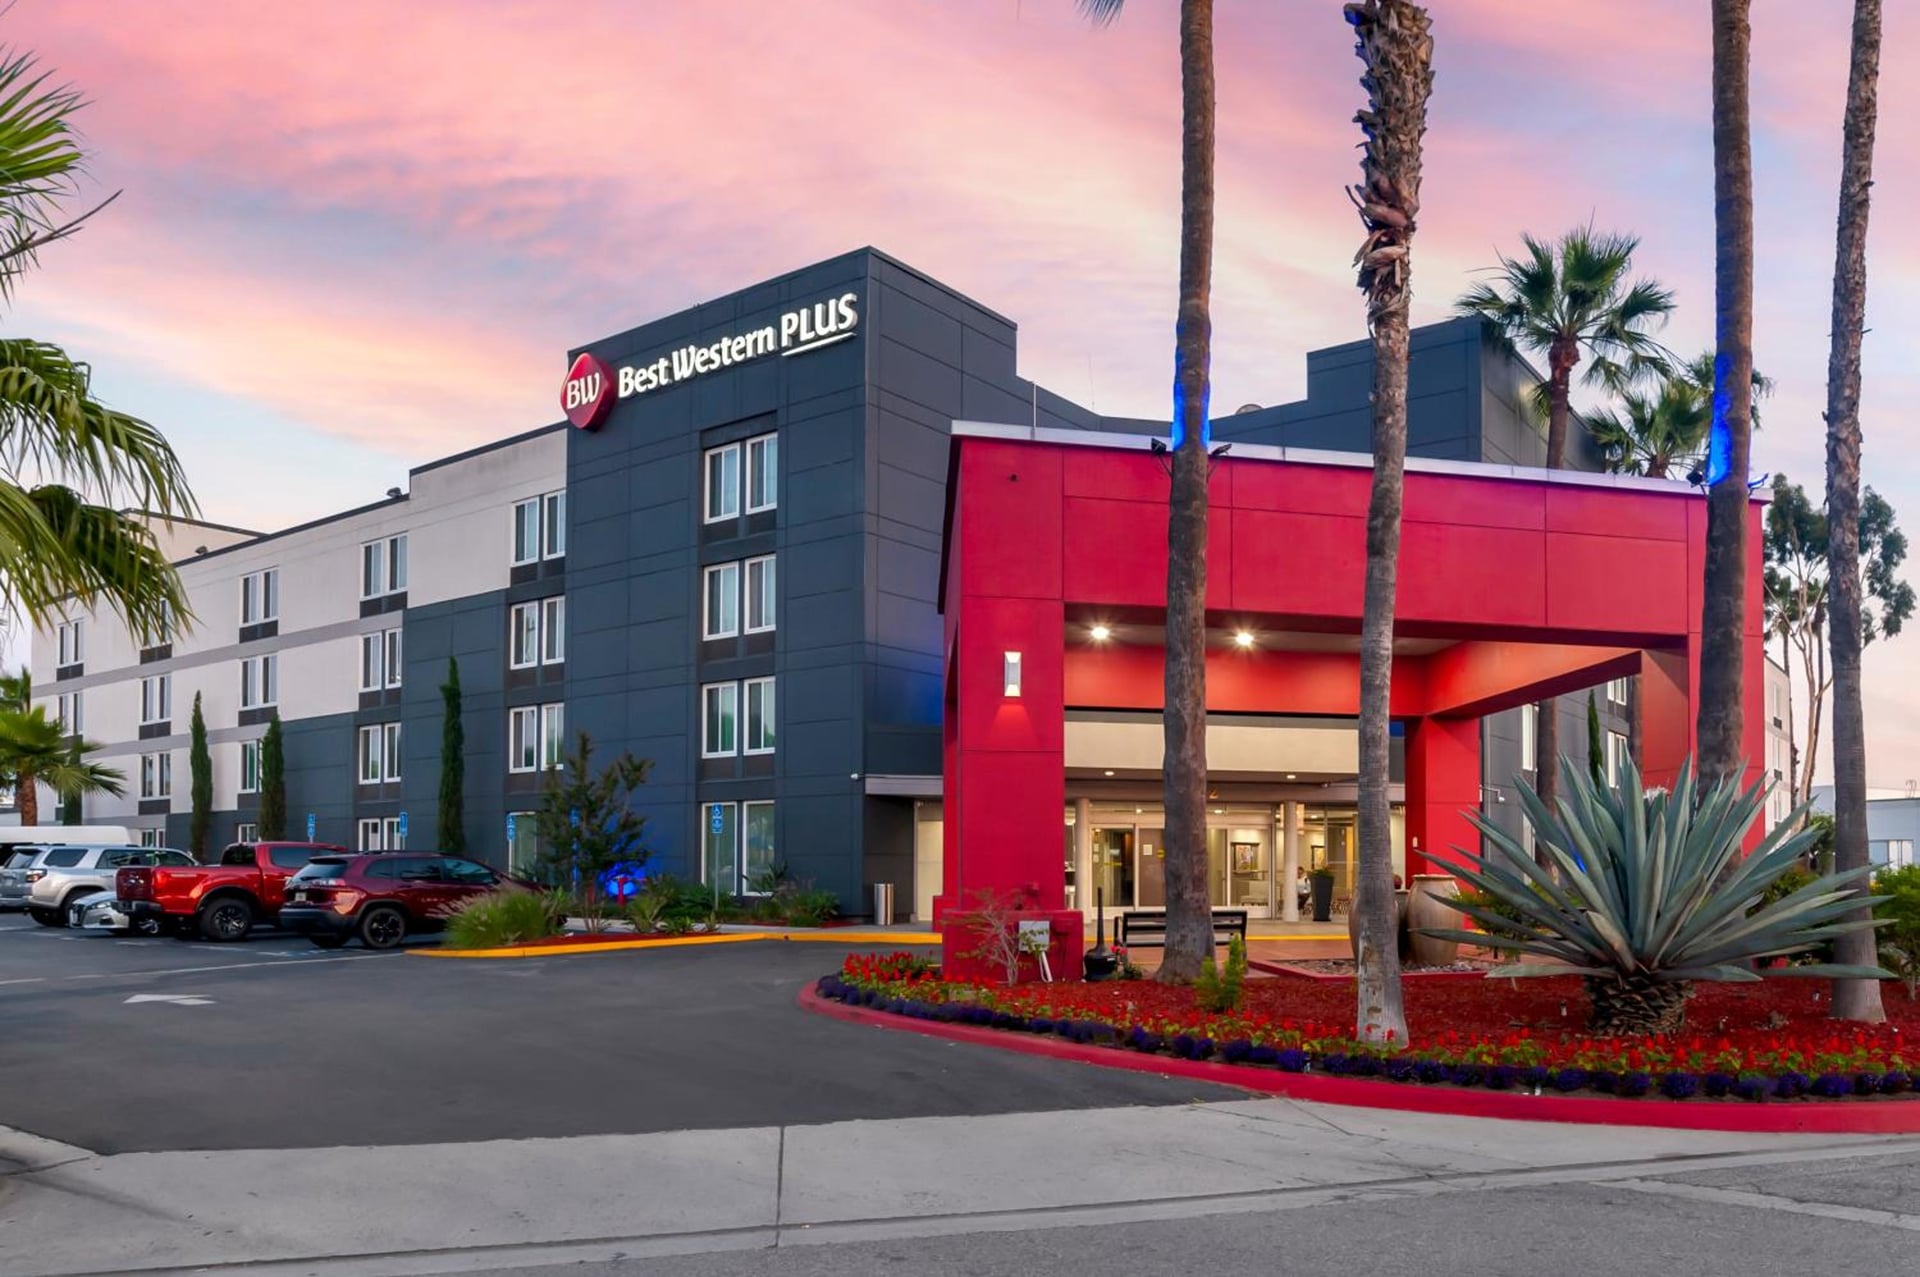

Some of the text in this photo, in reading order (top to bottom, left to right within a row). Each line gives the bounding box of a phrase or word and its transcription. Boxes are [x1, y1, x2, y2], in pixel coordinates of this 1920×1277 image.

[618, 292, 857, 398] Best Western PLUS
[567, 372, 600, 409] BW
